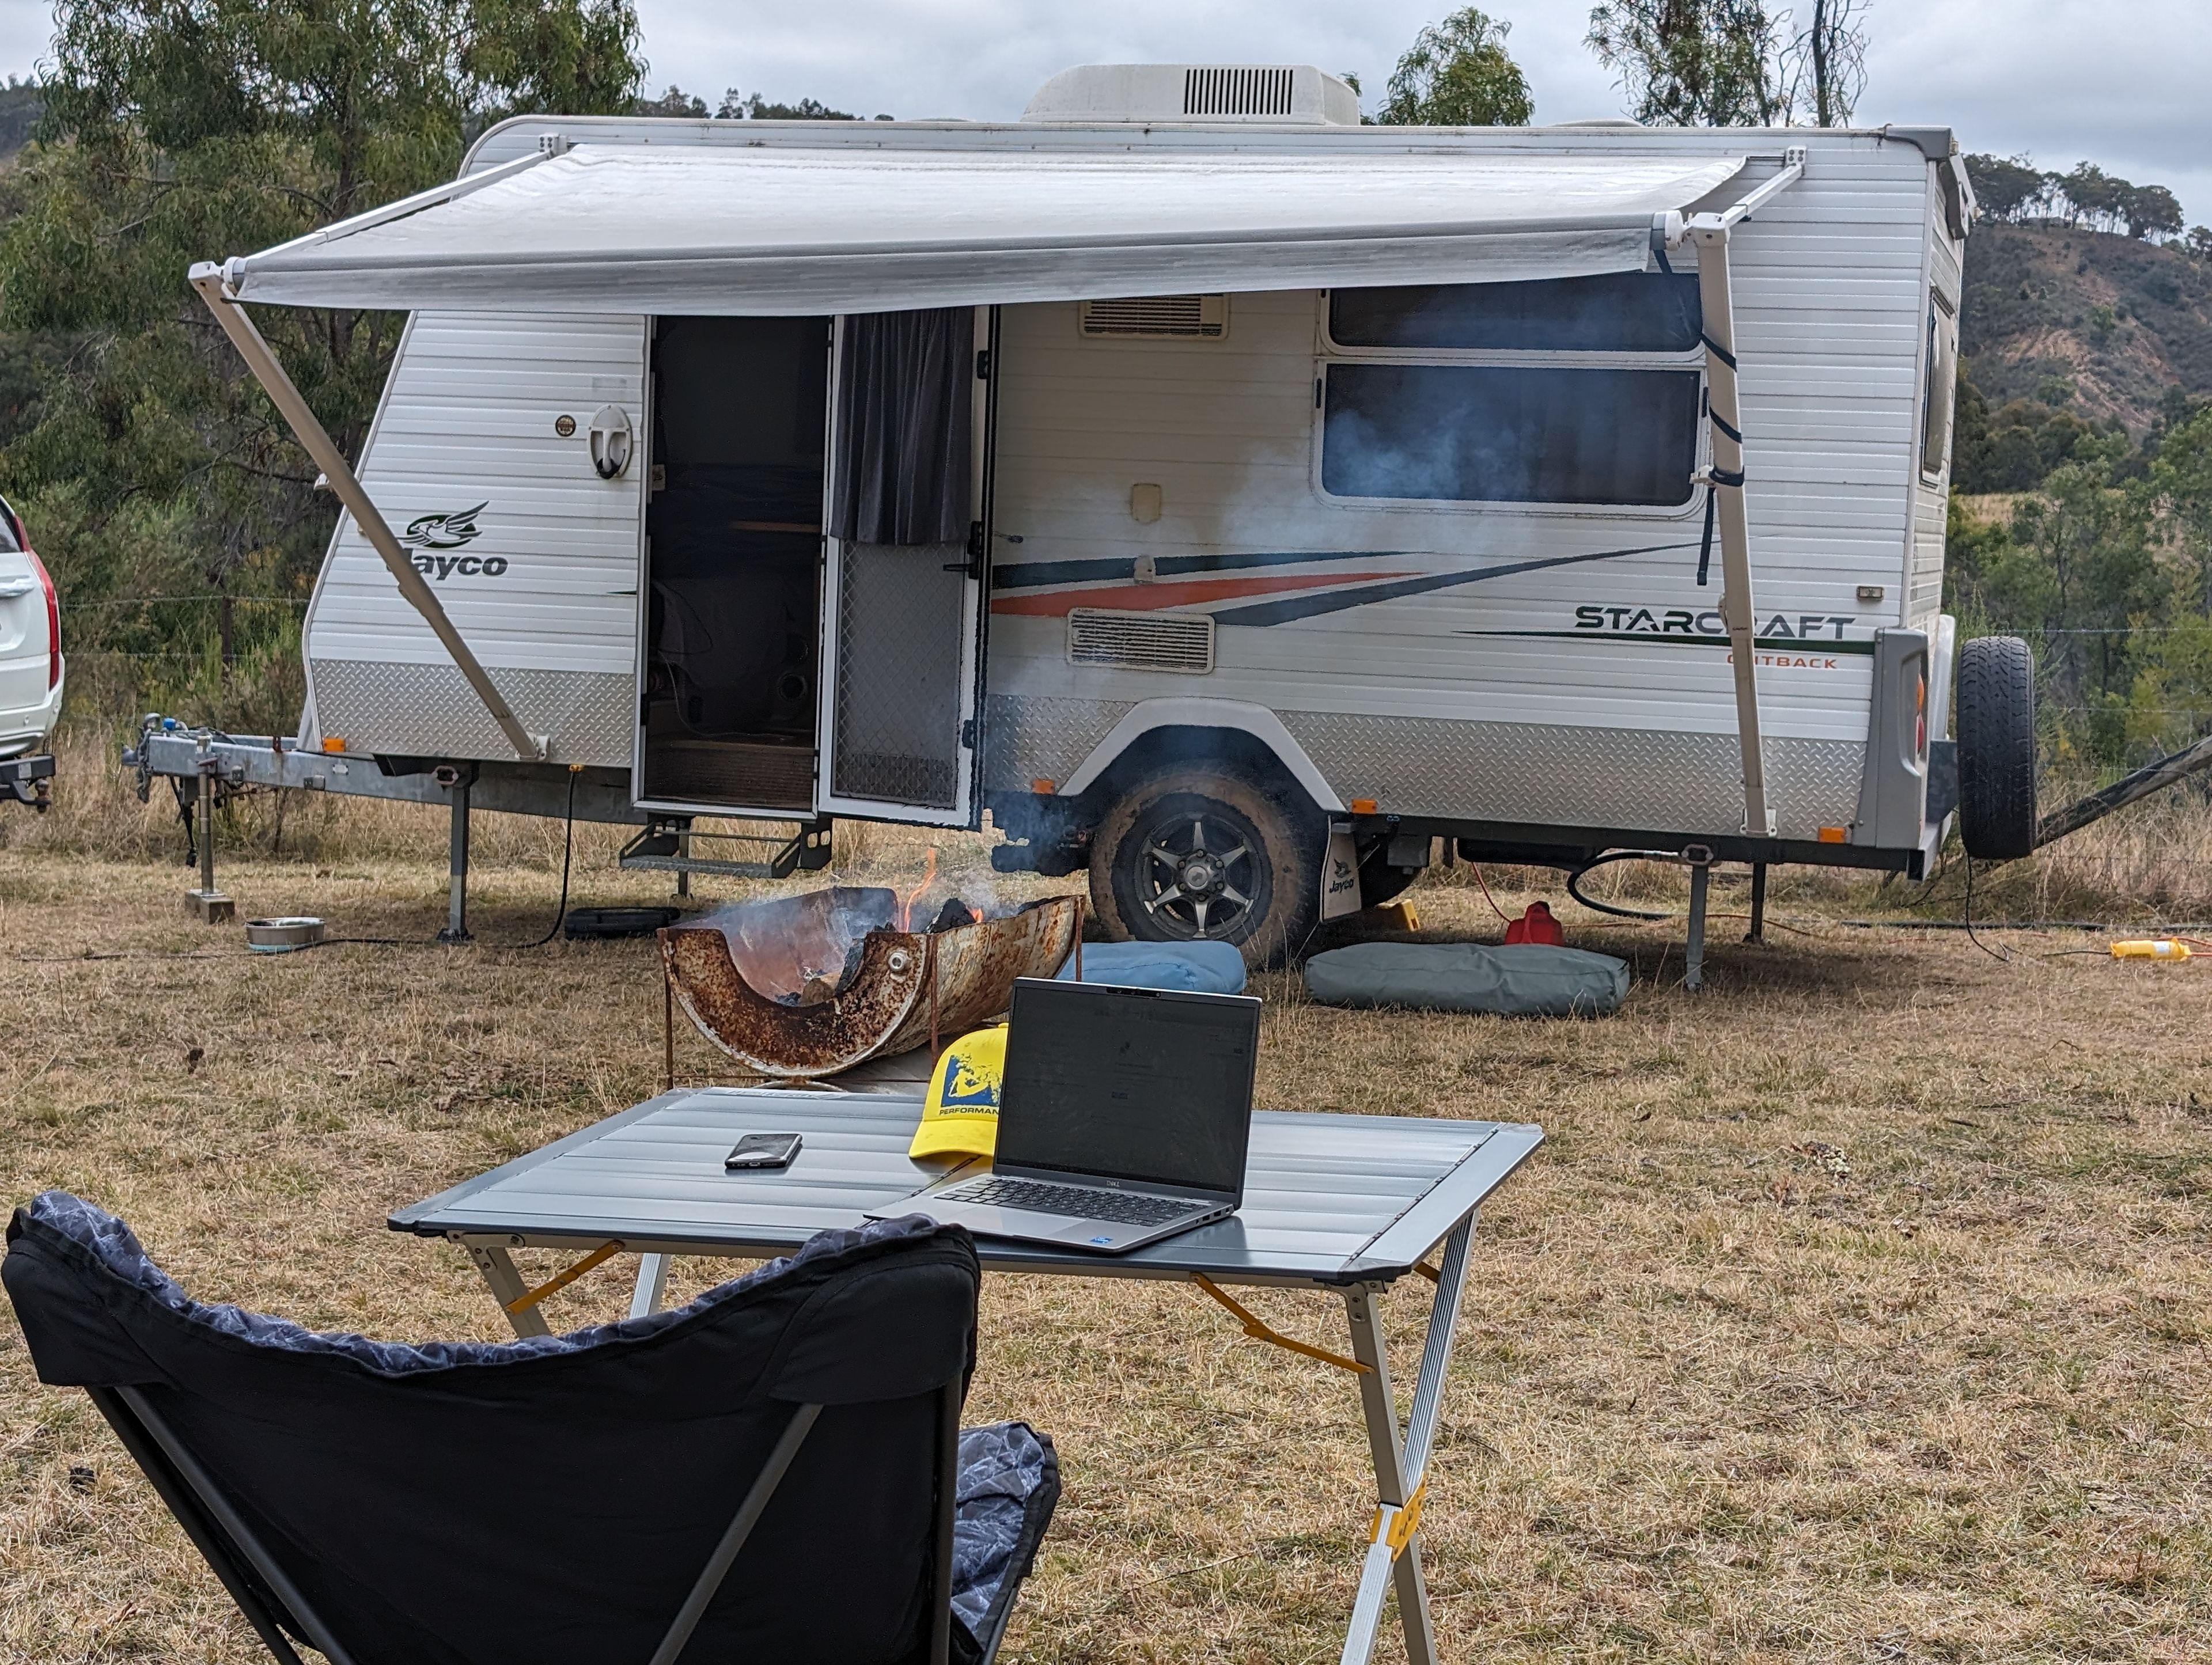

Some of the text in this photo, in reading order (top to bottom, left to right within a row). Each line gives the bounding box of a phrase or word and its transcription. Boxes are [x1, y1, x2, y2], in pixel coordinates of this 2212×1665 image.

[1575, 605, 1855, 640] STARCAFT
[1727, 654, 1837, 669] TBACK
[1329, 879, 1354, 893] Jayco
